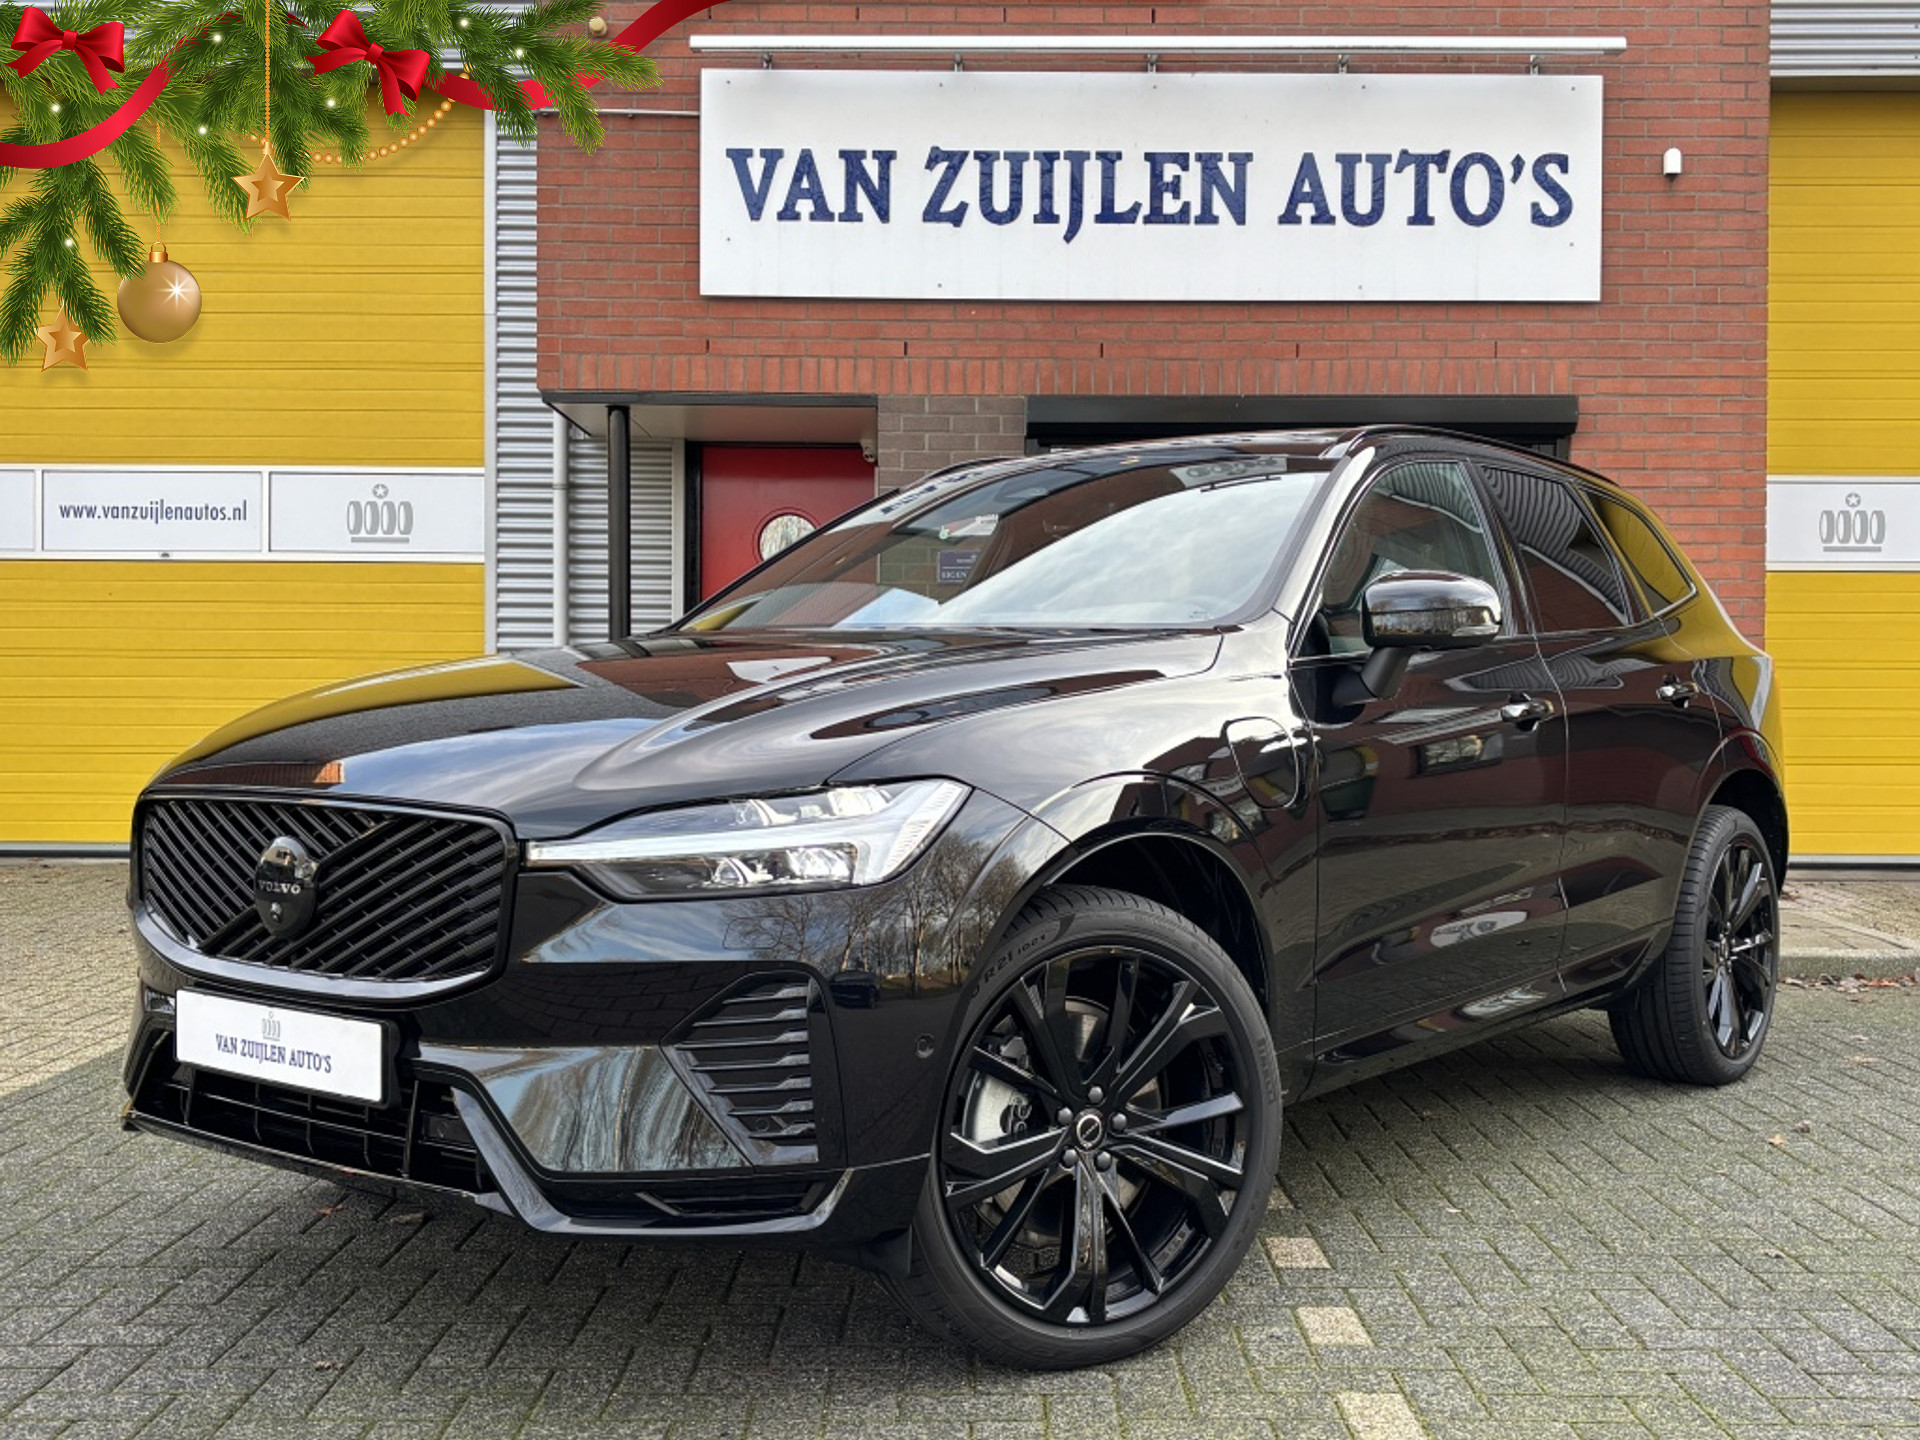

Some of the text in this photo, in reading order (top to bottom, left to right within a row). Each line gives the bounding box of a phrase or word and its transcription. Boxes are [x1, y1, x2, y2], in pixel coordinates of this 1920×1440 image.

[726, 147, 1573, 244] VAN ZUIJLEN AUTO'S
[59, 499, 247, 525] www.vanzuijlenautos.nl
[260, 881, 301, 895] VOLVO
[215, 1033, 332, 1074] VAN ZUIJLEN AUTO'S
